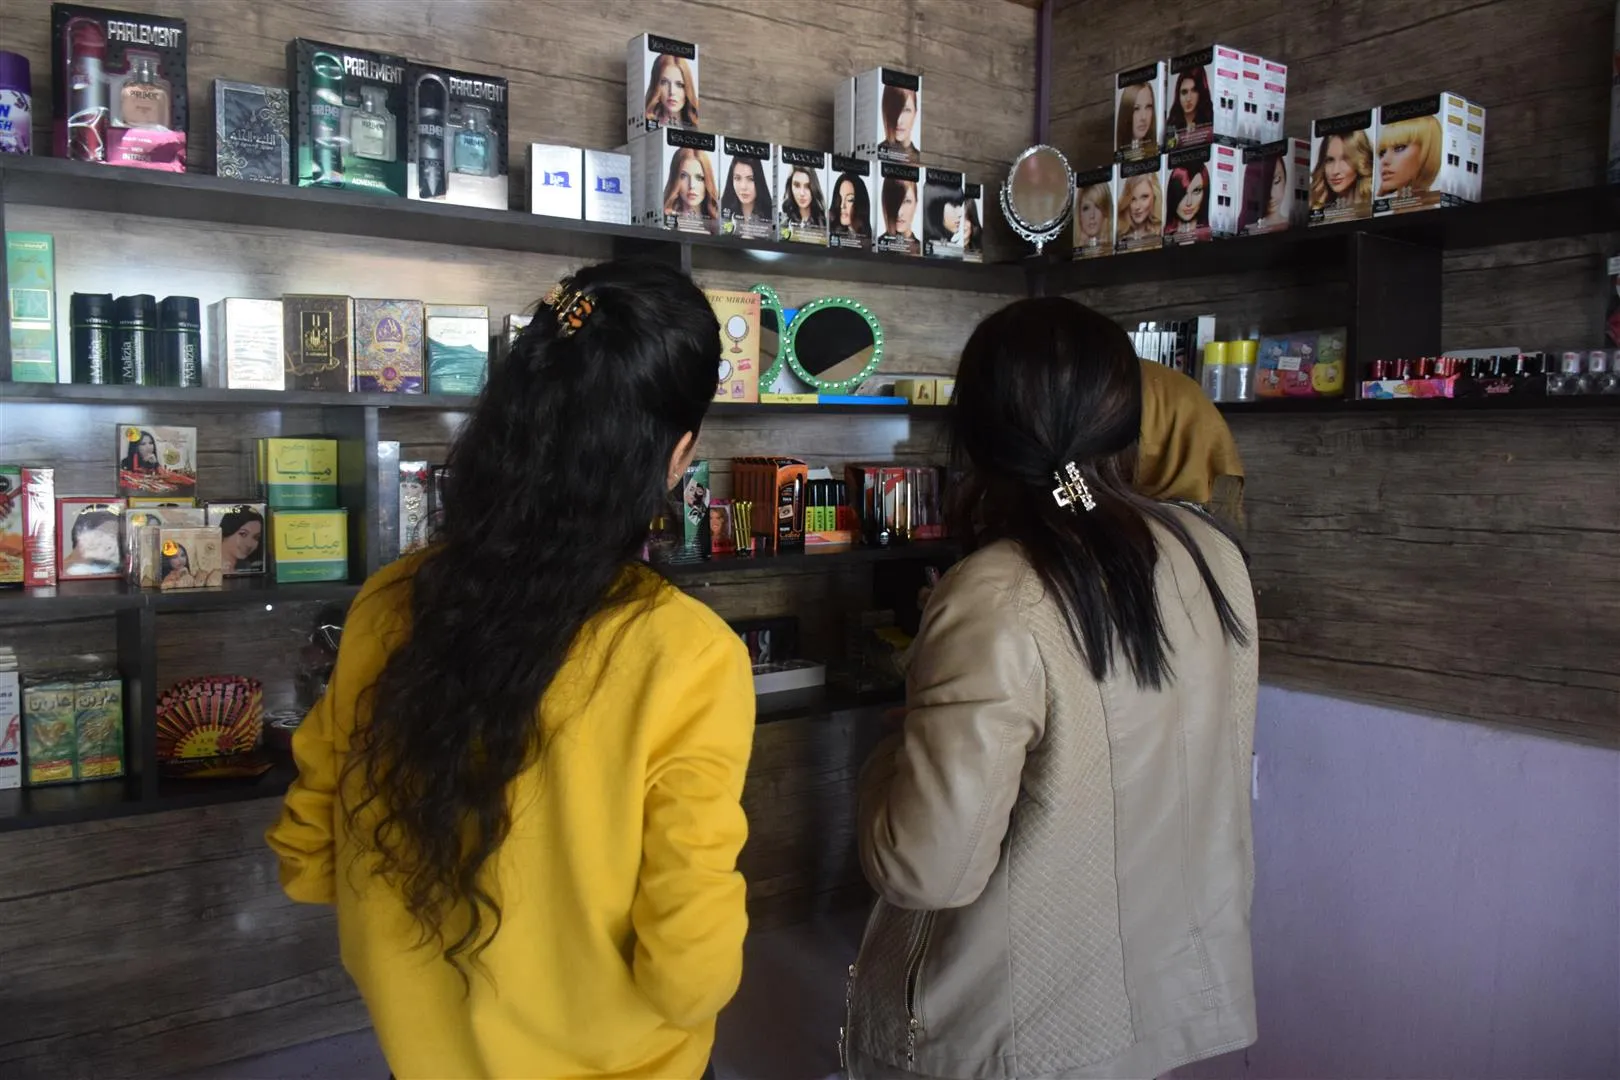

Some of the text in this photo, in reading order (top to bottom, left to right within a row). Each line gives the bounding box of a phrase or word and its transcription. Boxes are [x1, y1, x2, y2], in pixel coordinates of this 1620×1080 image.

[107, 20, 182, 48] PARLEMENT
[343, 55, 405, 84] PARLEMENT
[449, 77, 506, 102] PARLEMENT
[726, 296, 756, 305] MIRROR
[88, 339, 102, 377] Malizia
[122, 341, 133, 378] Malizia
[184, 344, 195, 379] Malizia
